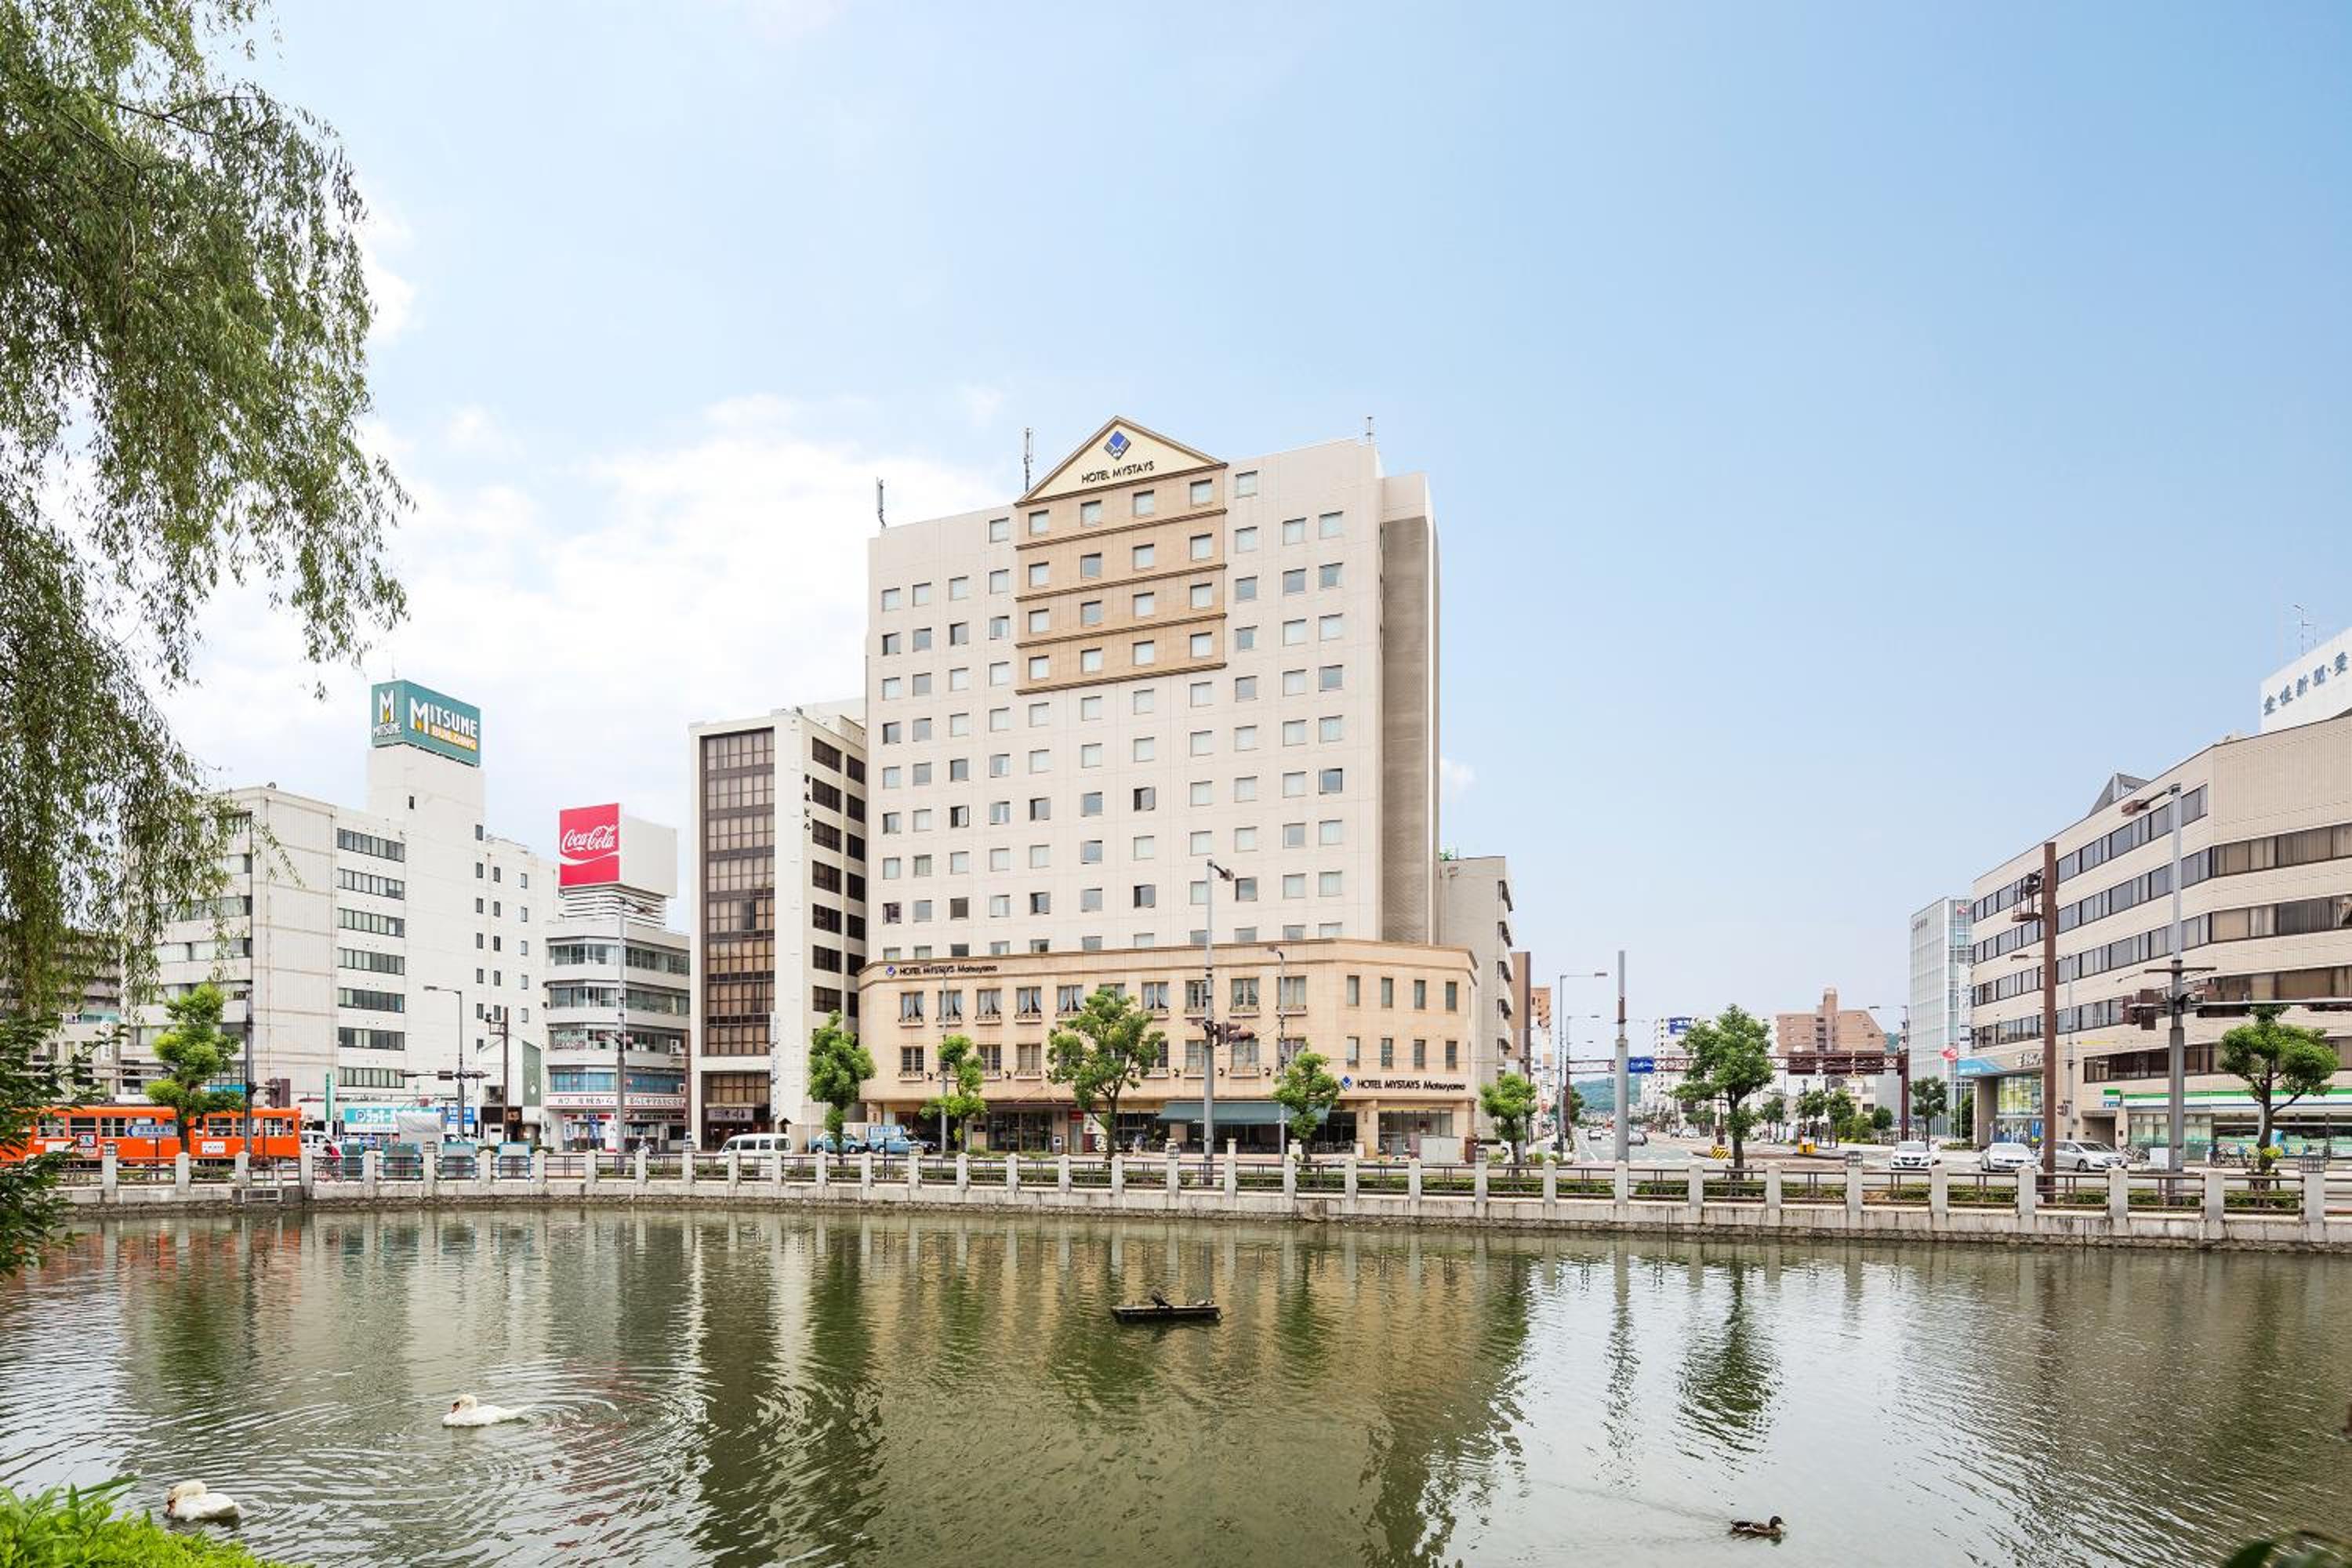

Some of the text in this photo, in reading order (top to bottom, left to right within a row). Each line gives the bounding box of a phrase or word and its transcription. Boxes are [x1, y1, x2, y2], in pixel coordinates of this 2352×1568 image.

[1081, 460, 1154, 483] HOTEL MYSTAYS
[410, 696, 477, 738] MITSUNE
[432, 725, 477, 750] BUILDING
[561, 825, 615, 853] Coca-Cola
[900, 967, 920, 975] HOTEL
[924, 966, 954, 975] MYSTAYS
[1357, 1080, 1466, 1091] HOTEL MYSTAYS Matsuyama
